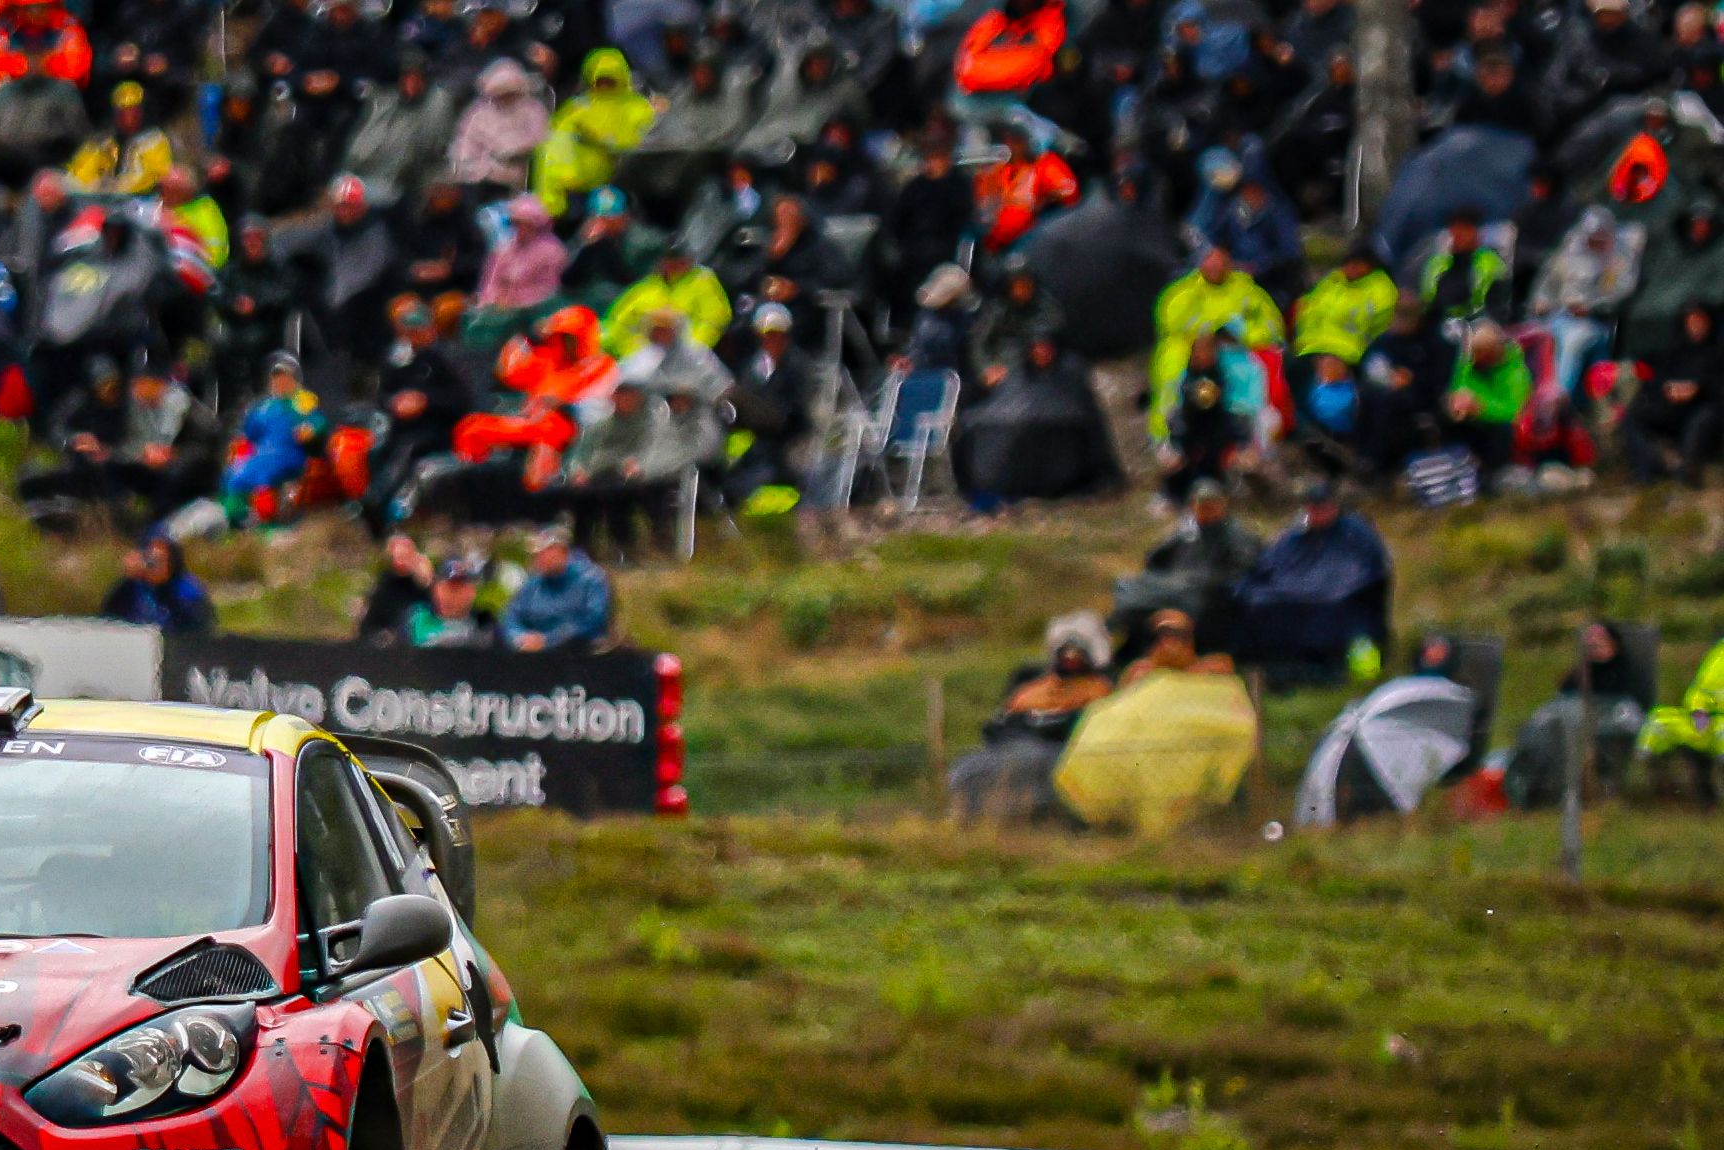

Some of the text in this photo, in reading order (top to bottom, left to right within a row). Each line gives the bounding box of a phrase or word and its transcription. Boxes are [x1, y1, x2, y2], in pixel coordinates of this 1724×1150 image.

[187, 666, 645, 744] Volvo Construction
[144, 746, 219, 767] FIA
